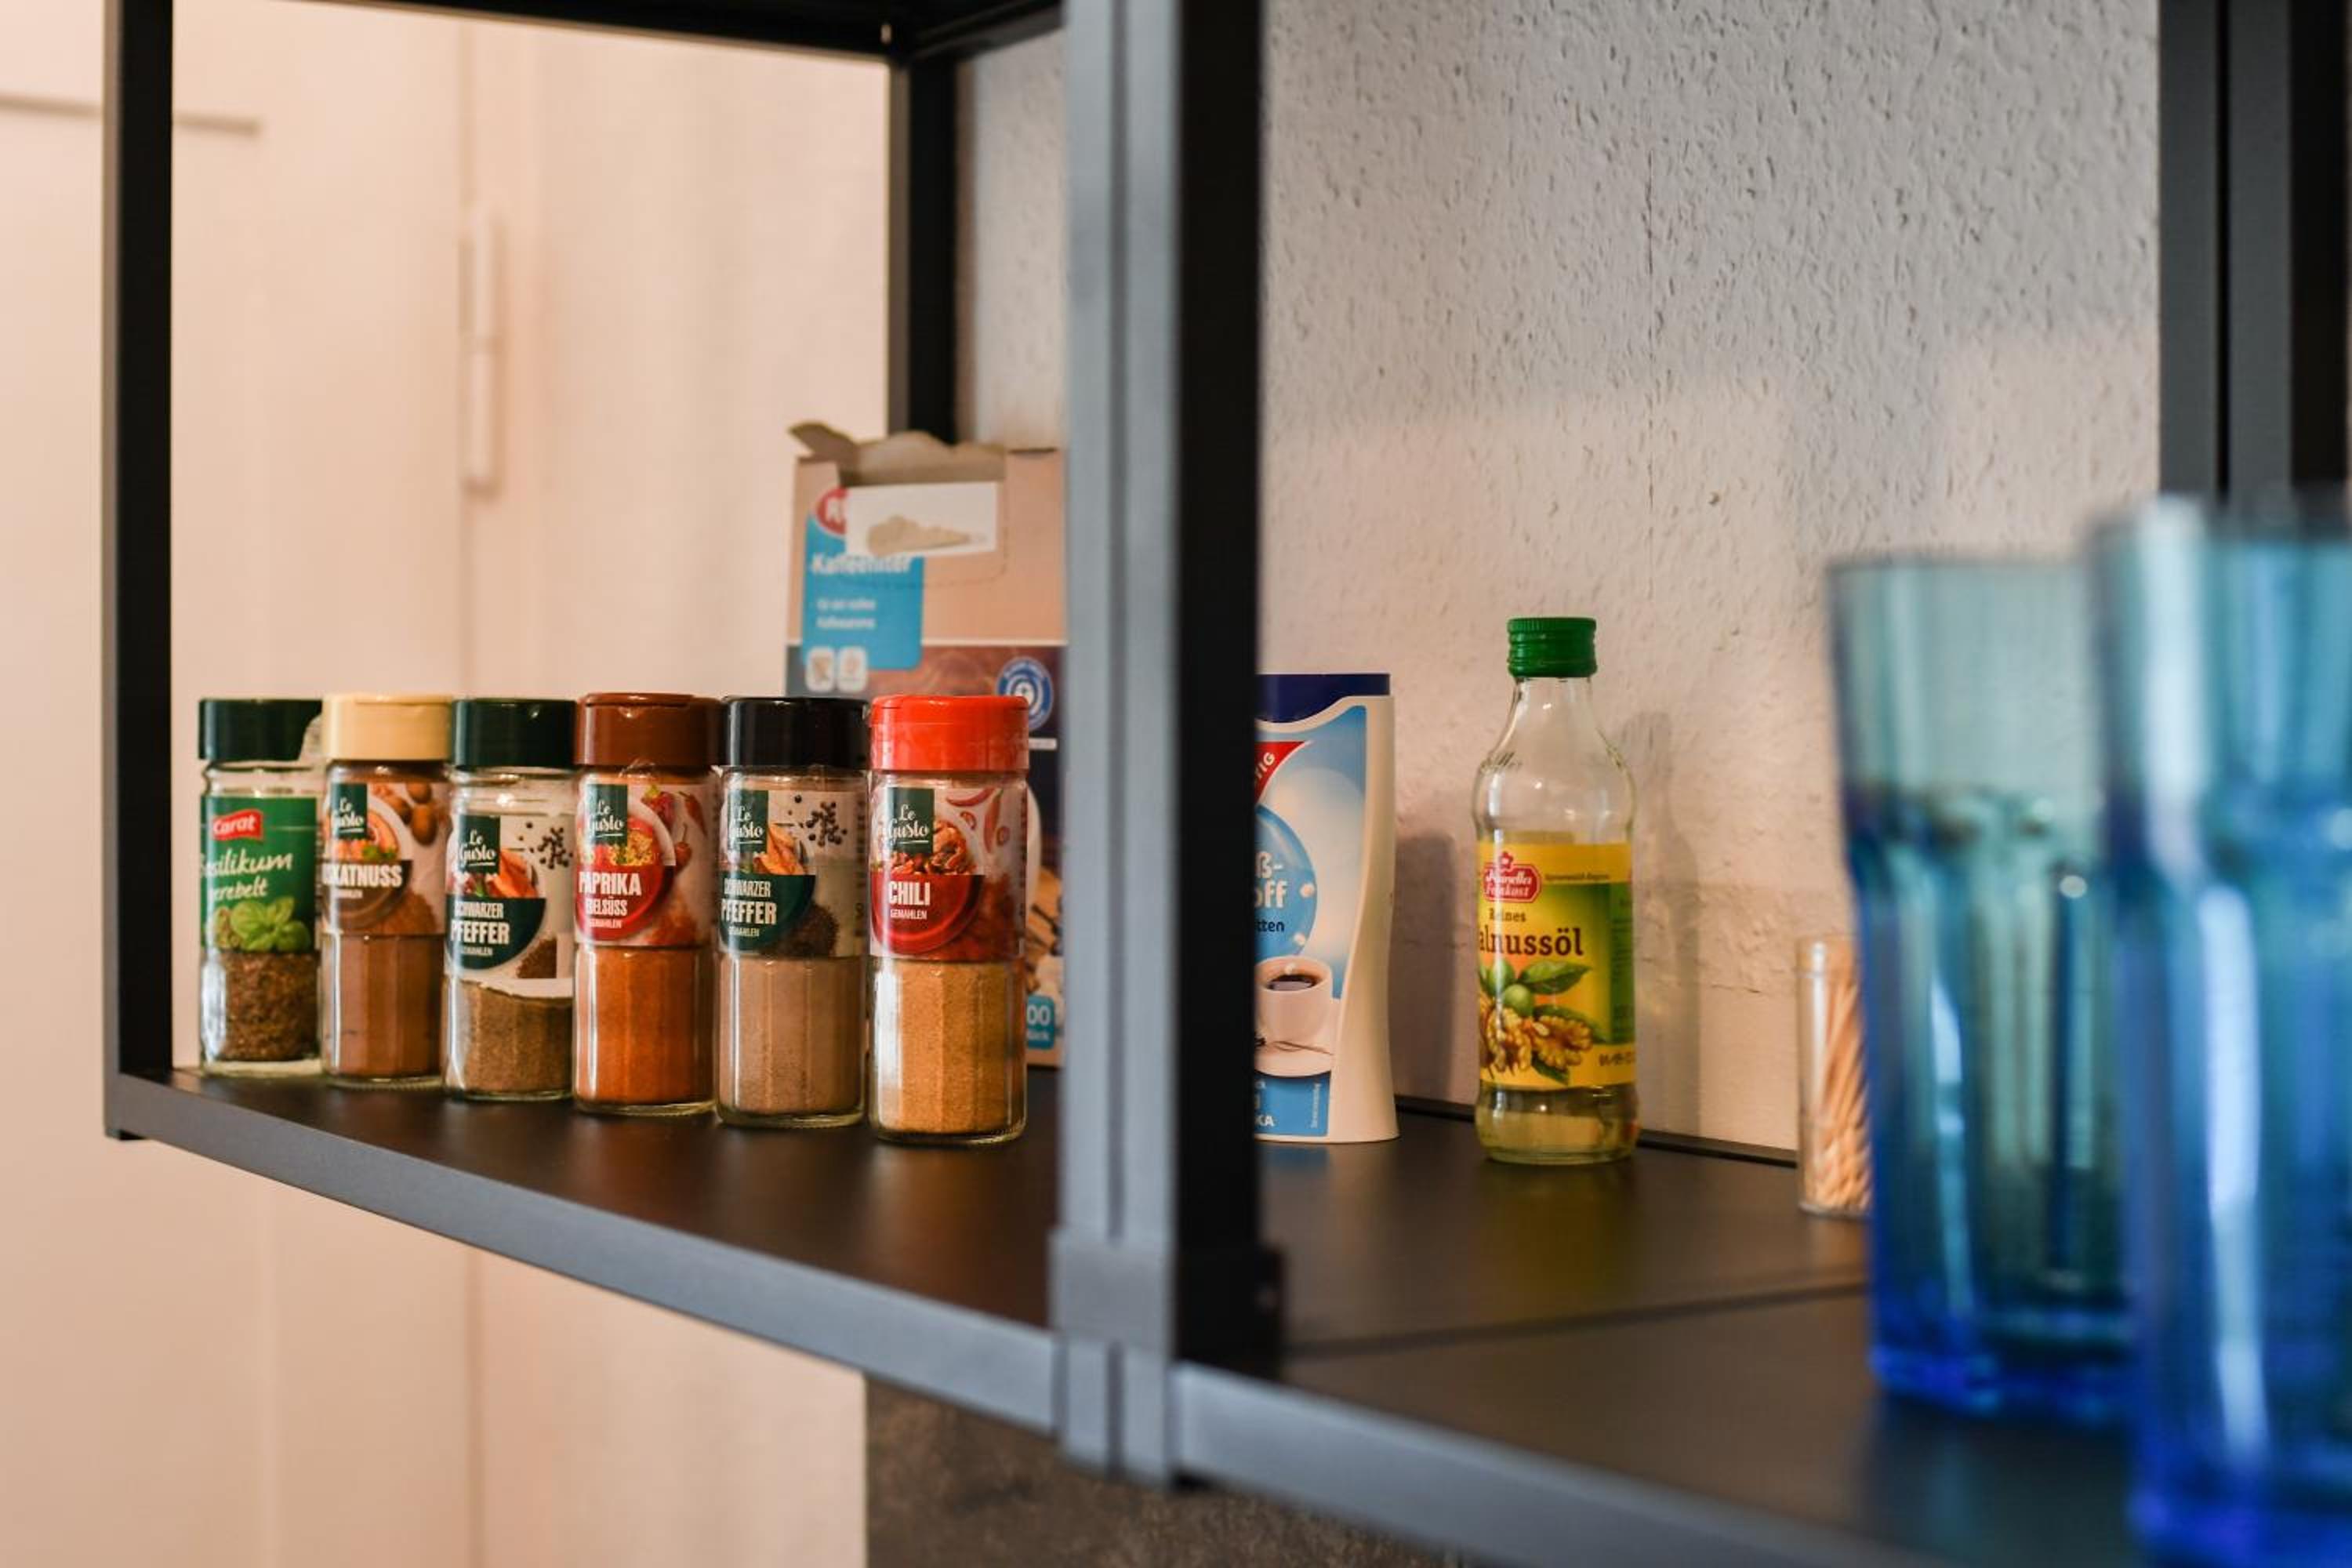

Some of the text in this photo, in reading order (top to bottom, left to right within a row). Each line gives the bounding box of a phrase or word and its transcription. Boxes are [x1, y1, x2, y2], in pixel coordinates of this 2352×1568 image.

[597, 800, 611, 815] Le
[737, 806, 752, 822] Le
[899, 804, 916, 821] Le
[213, 815, 256, 834] Carat
[888, 819, 930, 847] Gusto
[470, 830, 484, 845] Le
[1254, 851, 1283, 879] ß-
[579, 872, 642, 896] PAPRIKA
[888, 881, 931, 906] CHILI
[721, 898, 778, 925] PFEFFER
[451, 920, 510, 945] PFEFFER
[1479, 924, 1584, 956] alnussöl
